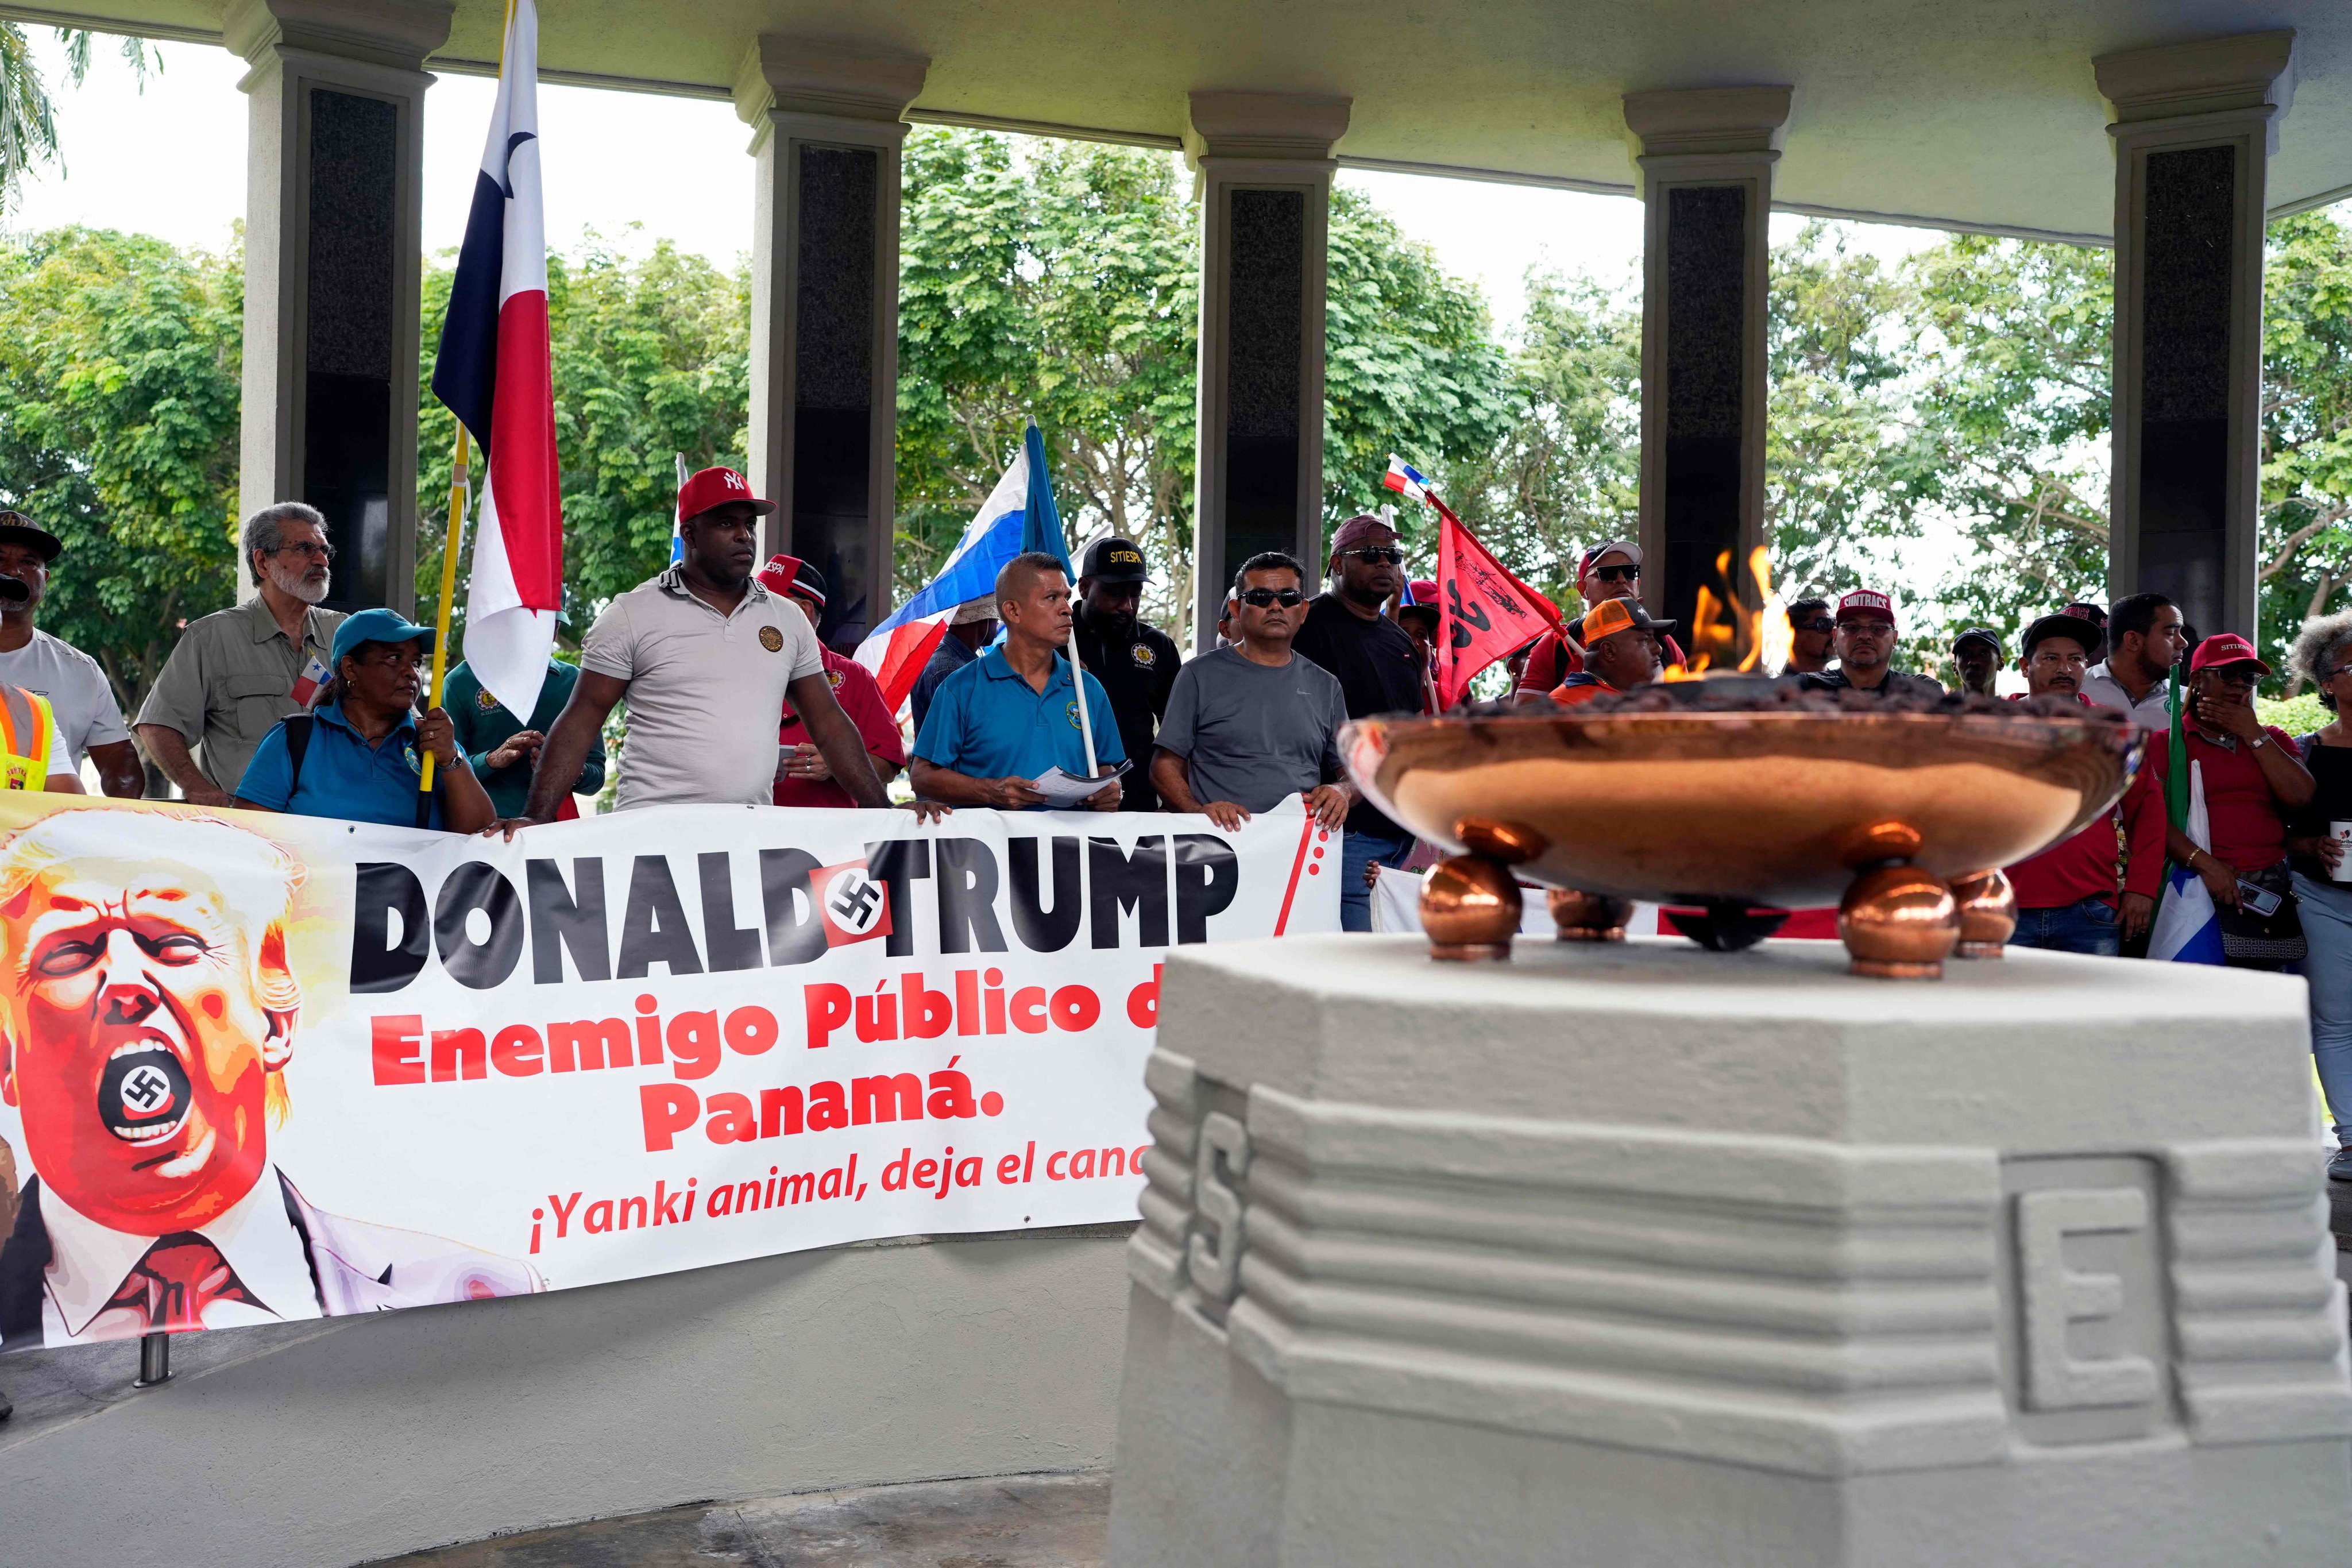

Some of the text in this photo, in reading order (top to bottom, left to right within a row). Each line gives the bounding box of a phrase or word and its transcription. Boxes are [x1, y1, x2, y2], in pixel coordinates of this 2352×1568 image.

[1110, 550, 1142, 564] SITIESPA
[1844, 593, 1887, 609] SUNTRACS
[349, 833, 1239, 994] DONALD TRUMP
[370, 963, 1165, 1086] Enemigo Público d
[640, 1055, 1003, 1152] Panamá.
[530, 1177, 696, 1254] ¡Yanki
[707, 1153, 867, 1218] animal,
[882, 1146, 983, 1200] deja
[997, 1141, 1035, 1184] el
[1189, 1110, 1246, 1297] S
[2021, 1188, 2157, 1408] E
